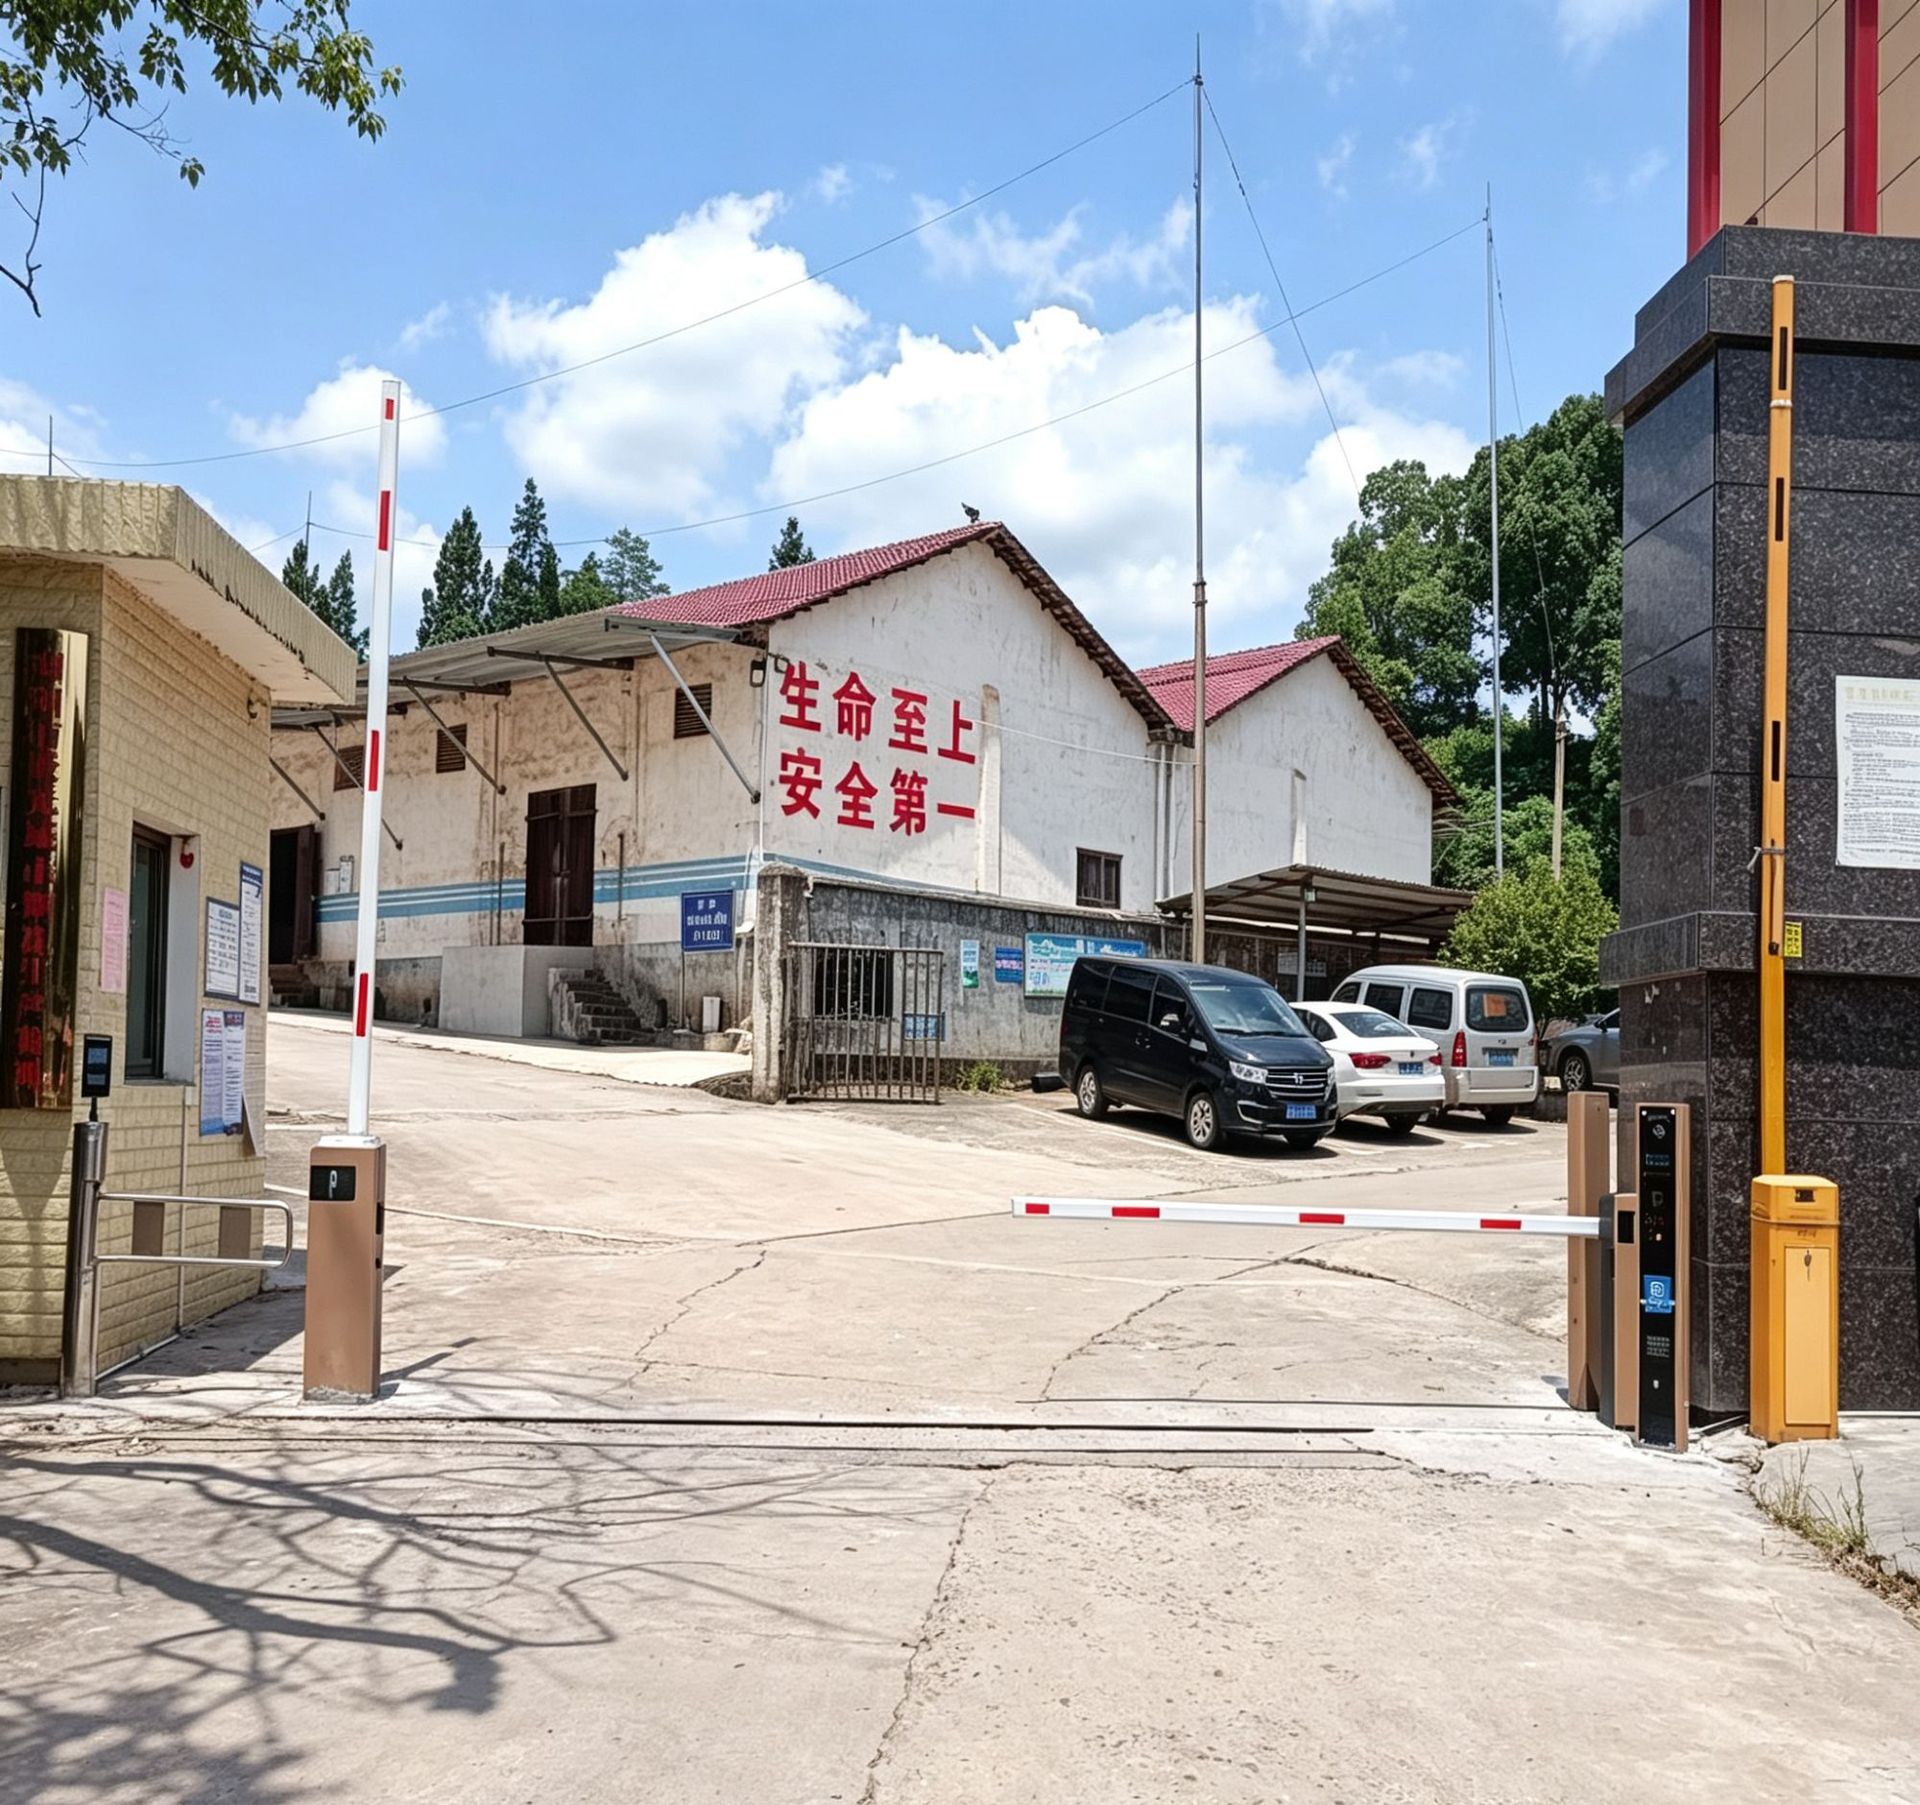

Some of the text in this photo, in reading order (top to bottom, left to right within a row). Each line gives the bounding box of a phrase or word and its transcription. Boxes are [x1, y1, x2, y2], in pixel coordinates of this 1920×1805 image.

[779, 661, 977, 765] 生命至上
[778, 747, 976, 836] 安全第一
